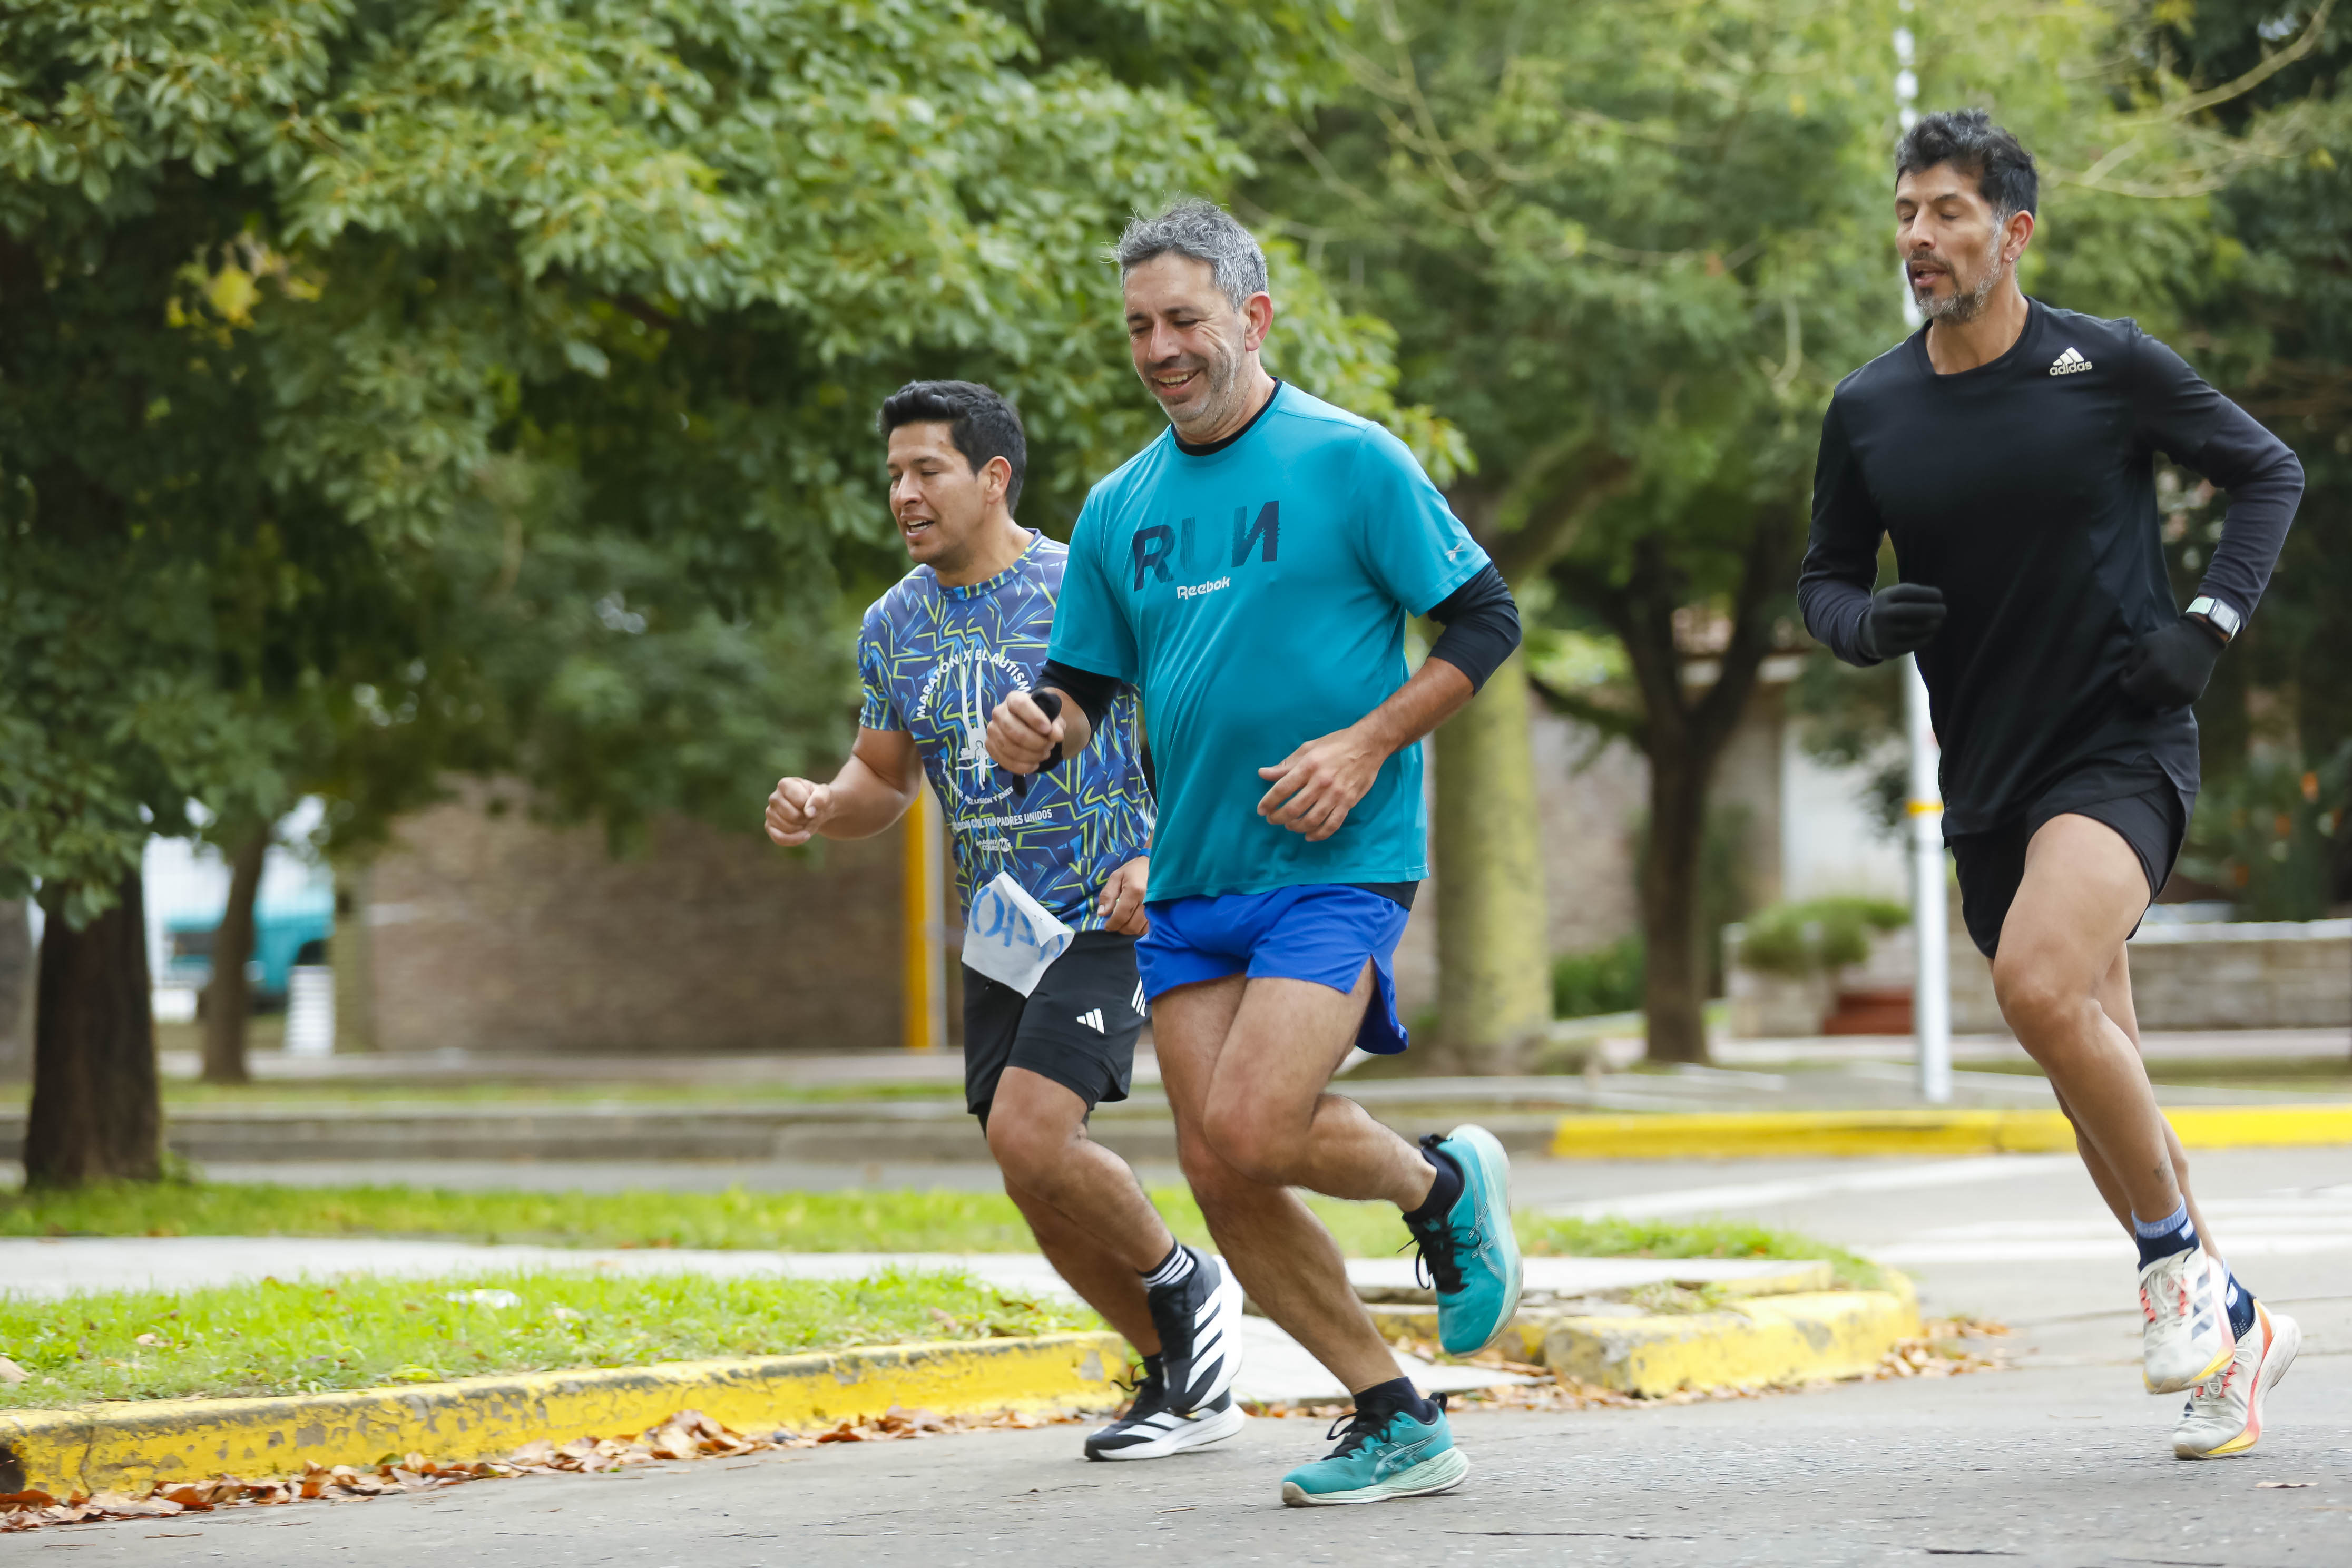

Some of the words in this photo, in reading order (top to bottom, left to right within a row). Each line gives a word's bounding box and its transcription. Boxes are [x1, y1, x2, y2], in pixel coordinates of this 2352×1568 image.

[2049, 361, 2093, 376] adidas
[1177, 575, 1231, 600] Reebok
[963, 650, 972, 662] X
[974, 649, 987, 661] EL
[989, 652, 1032, 693] AUTISM
[998, 786, 1014, 800] ENER
[983, 817, 996, 827] TGD
[997, 815, 1023, 827] PADRES
[1024, 808, 1053, 822] UNIDOS
